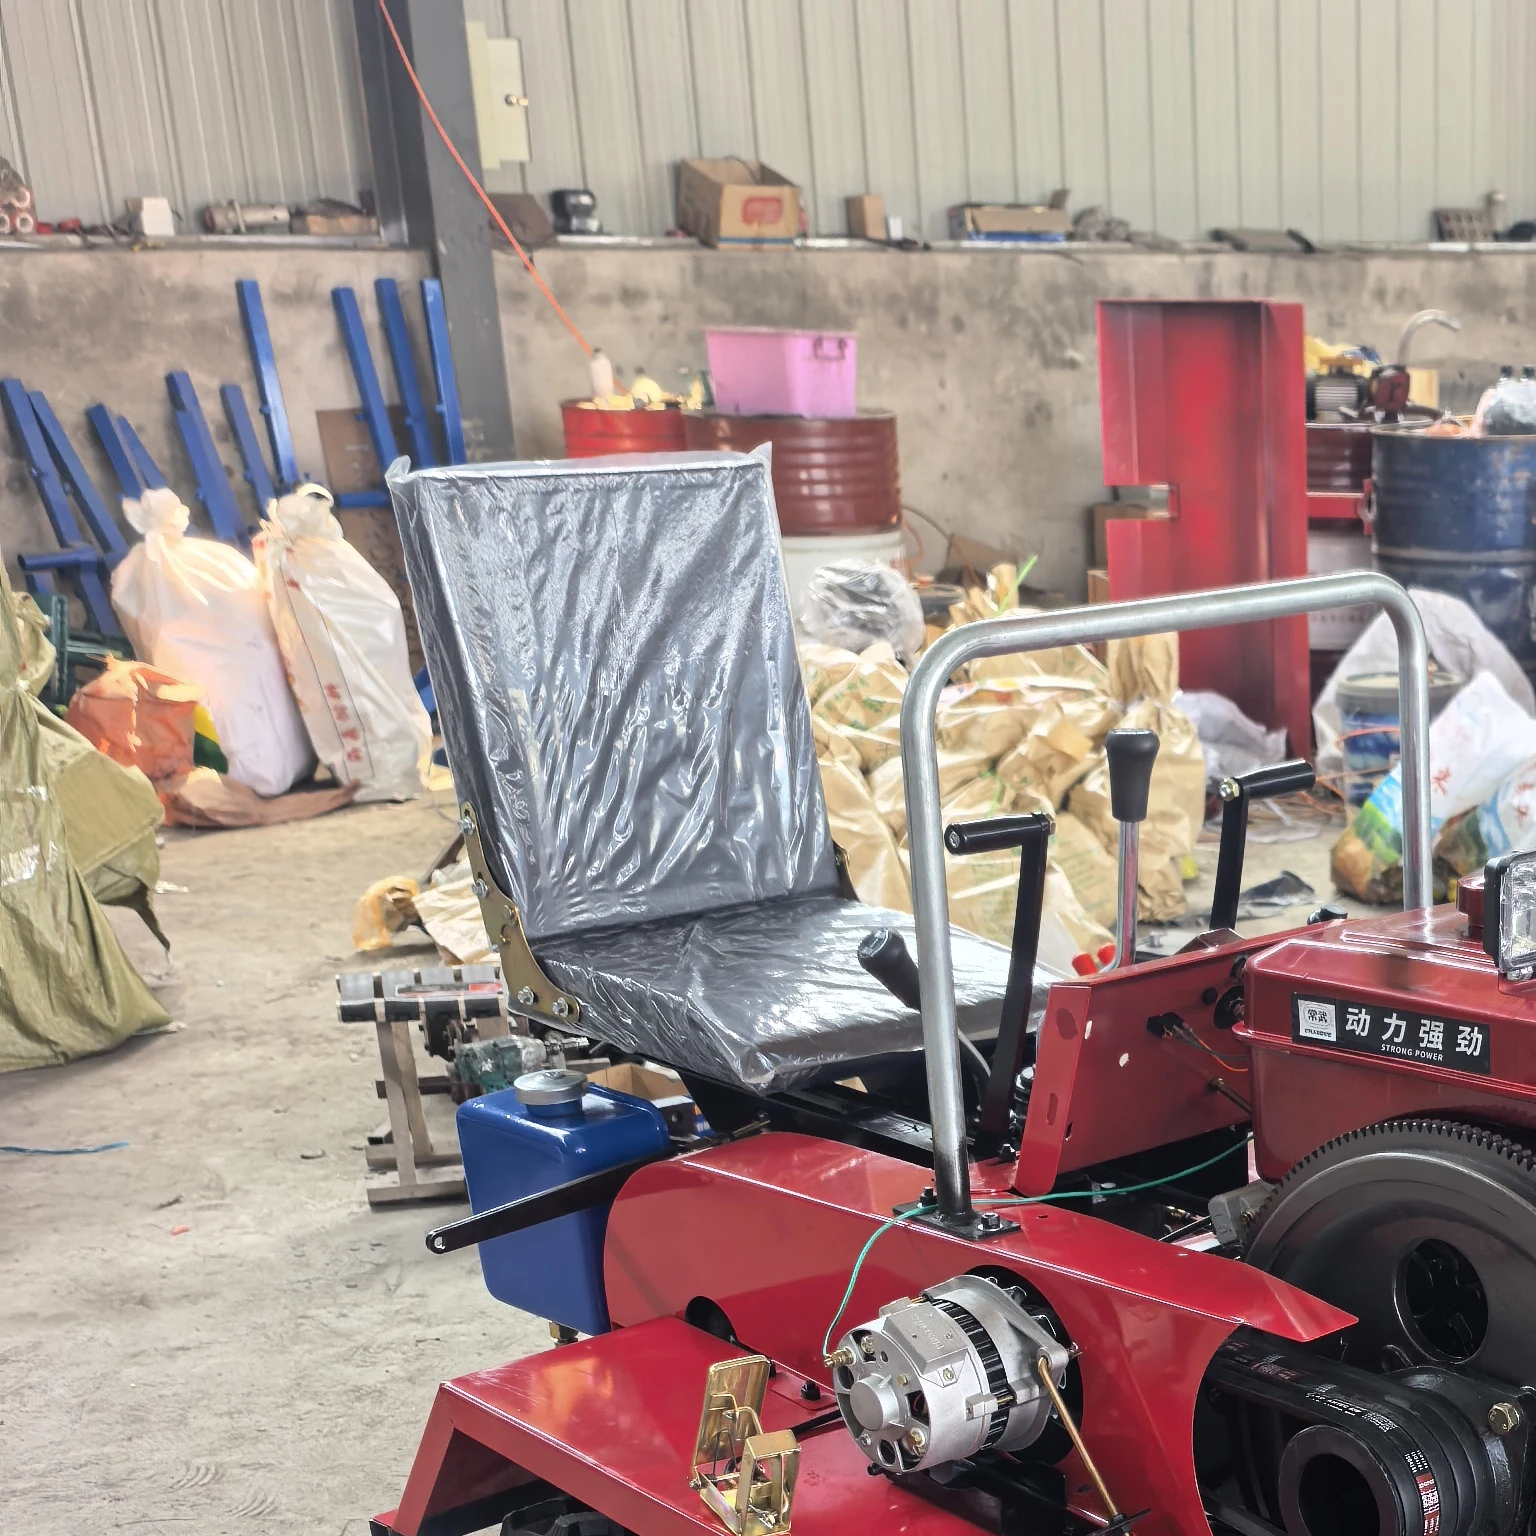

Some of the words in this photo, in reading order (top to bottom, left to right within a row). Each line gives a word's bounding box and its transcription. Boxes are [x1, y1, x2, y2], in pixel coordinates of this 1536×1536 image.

[1345, 1007, 1483, 1057] 动力强劲
[1380, 1043, 1413, 1057] STRONG
[1414, 1049, 1444, 1063] POWER
